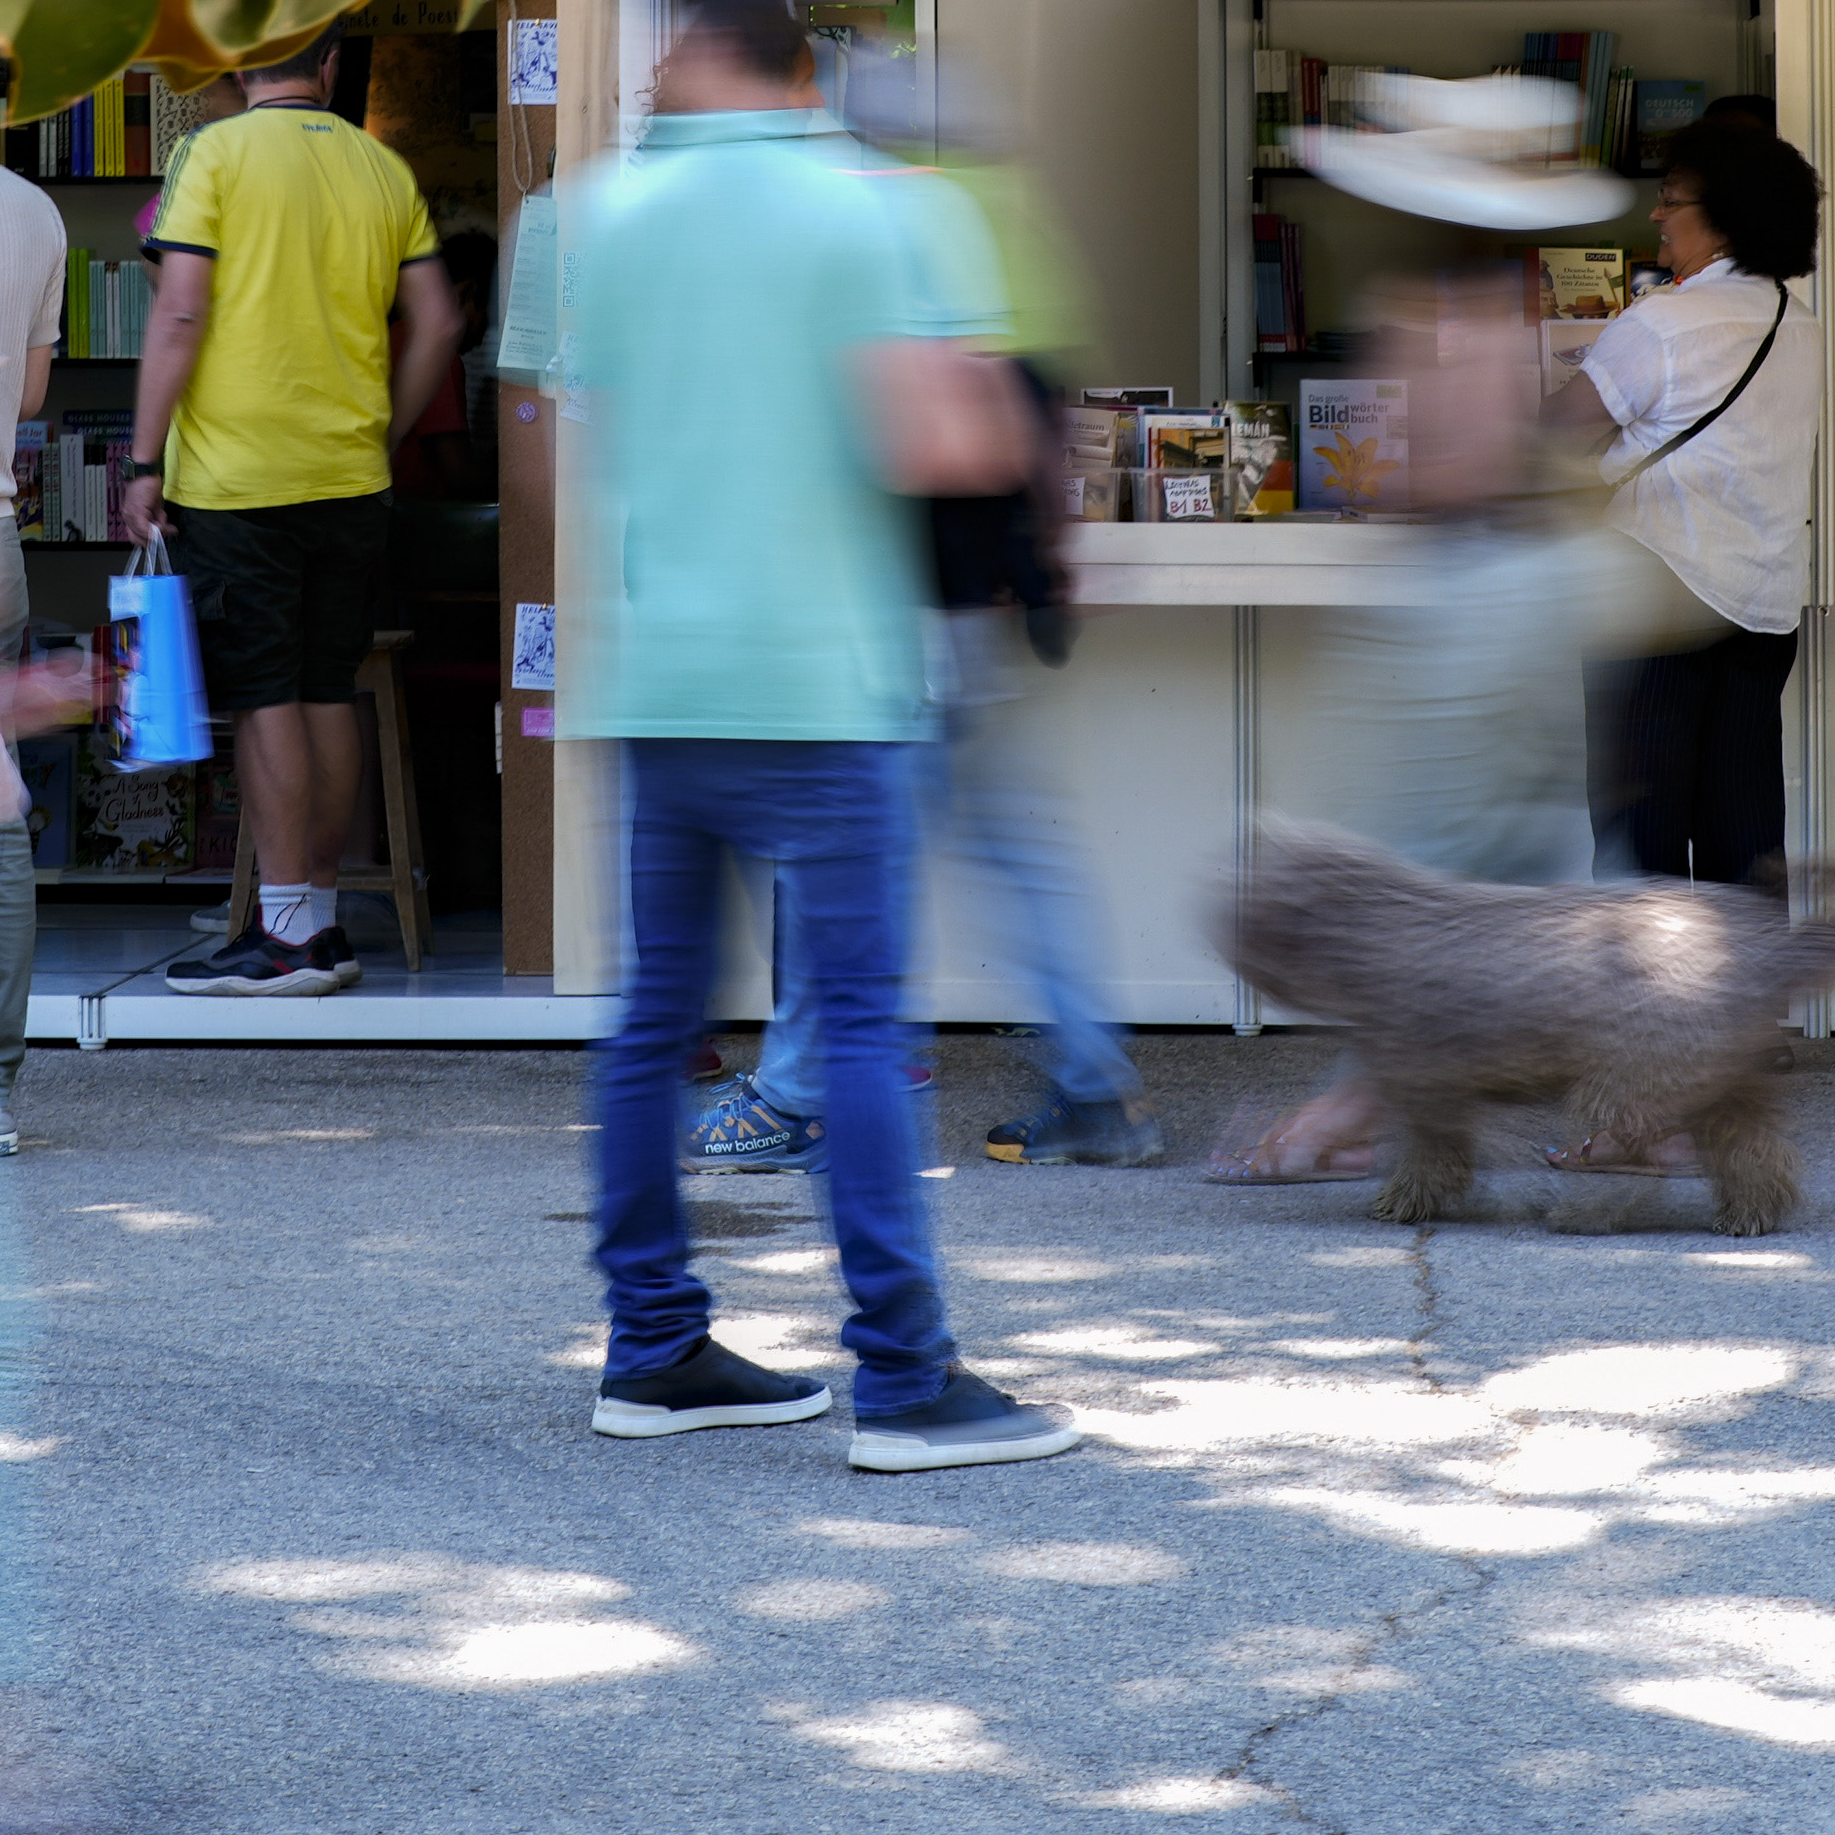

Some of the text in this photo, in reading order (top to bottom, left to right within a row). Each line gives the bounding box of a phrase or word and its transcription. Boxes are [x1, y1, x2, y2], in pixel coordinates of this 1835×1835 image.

[392, 3, 408, 26] de
[1646, 98, 1694, 109] DEUTSCH
[1585, 252, 1617, 262] DUDEN
[1308, 394, 1324, 403] Das
[67, 414, 94, 423] GLASS
[1309, 402, 1389, 423] Bild wörter
[1350, 413, 1379, 423] buch
[1170, 498, 1213, 515] B1 B2
[128, 774, 160, 802] Song
[105, 797, 164, 823] Gladness
